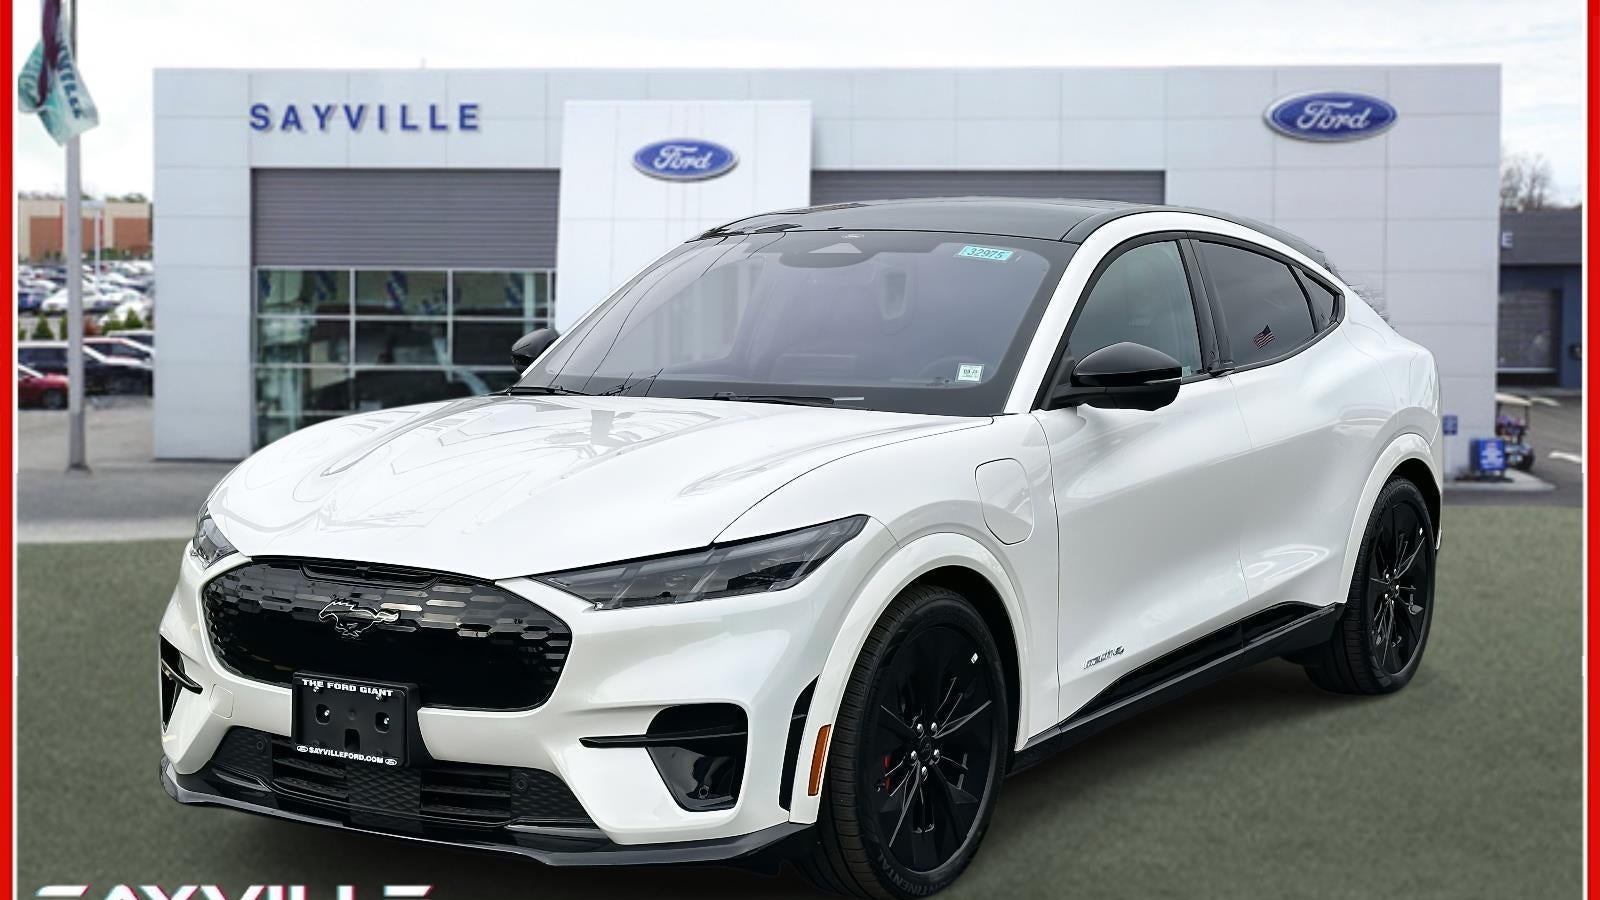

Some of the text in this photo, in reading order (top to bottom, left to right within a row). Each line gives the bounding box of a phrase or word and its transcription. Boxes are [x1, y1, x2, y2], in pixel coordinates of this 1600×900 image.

[249, 103, 480, 132] SAYVILLE
[1297, 100, 1371, 129] Ford
[653, 144, 713, 170] Ford
[967, 247, 1004, 259] 32975
[302, 679, 393, 696] THE FORD GIANT
[308, 746, 384, 764] SAYVILLEFORD.COM
